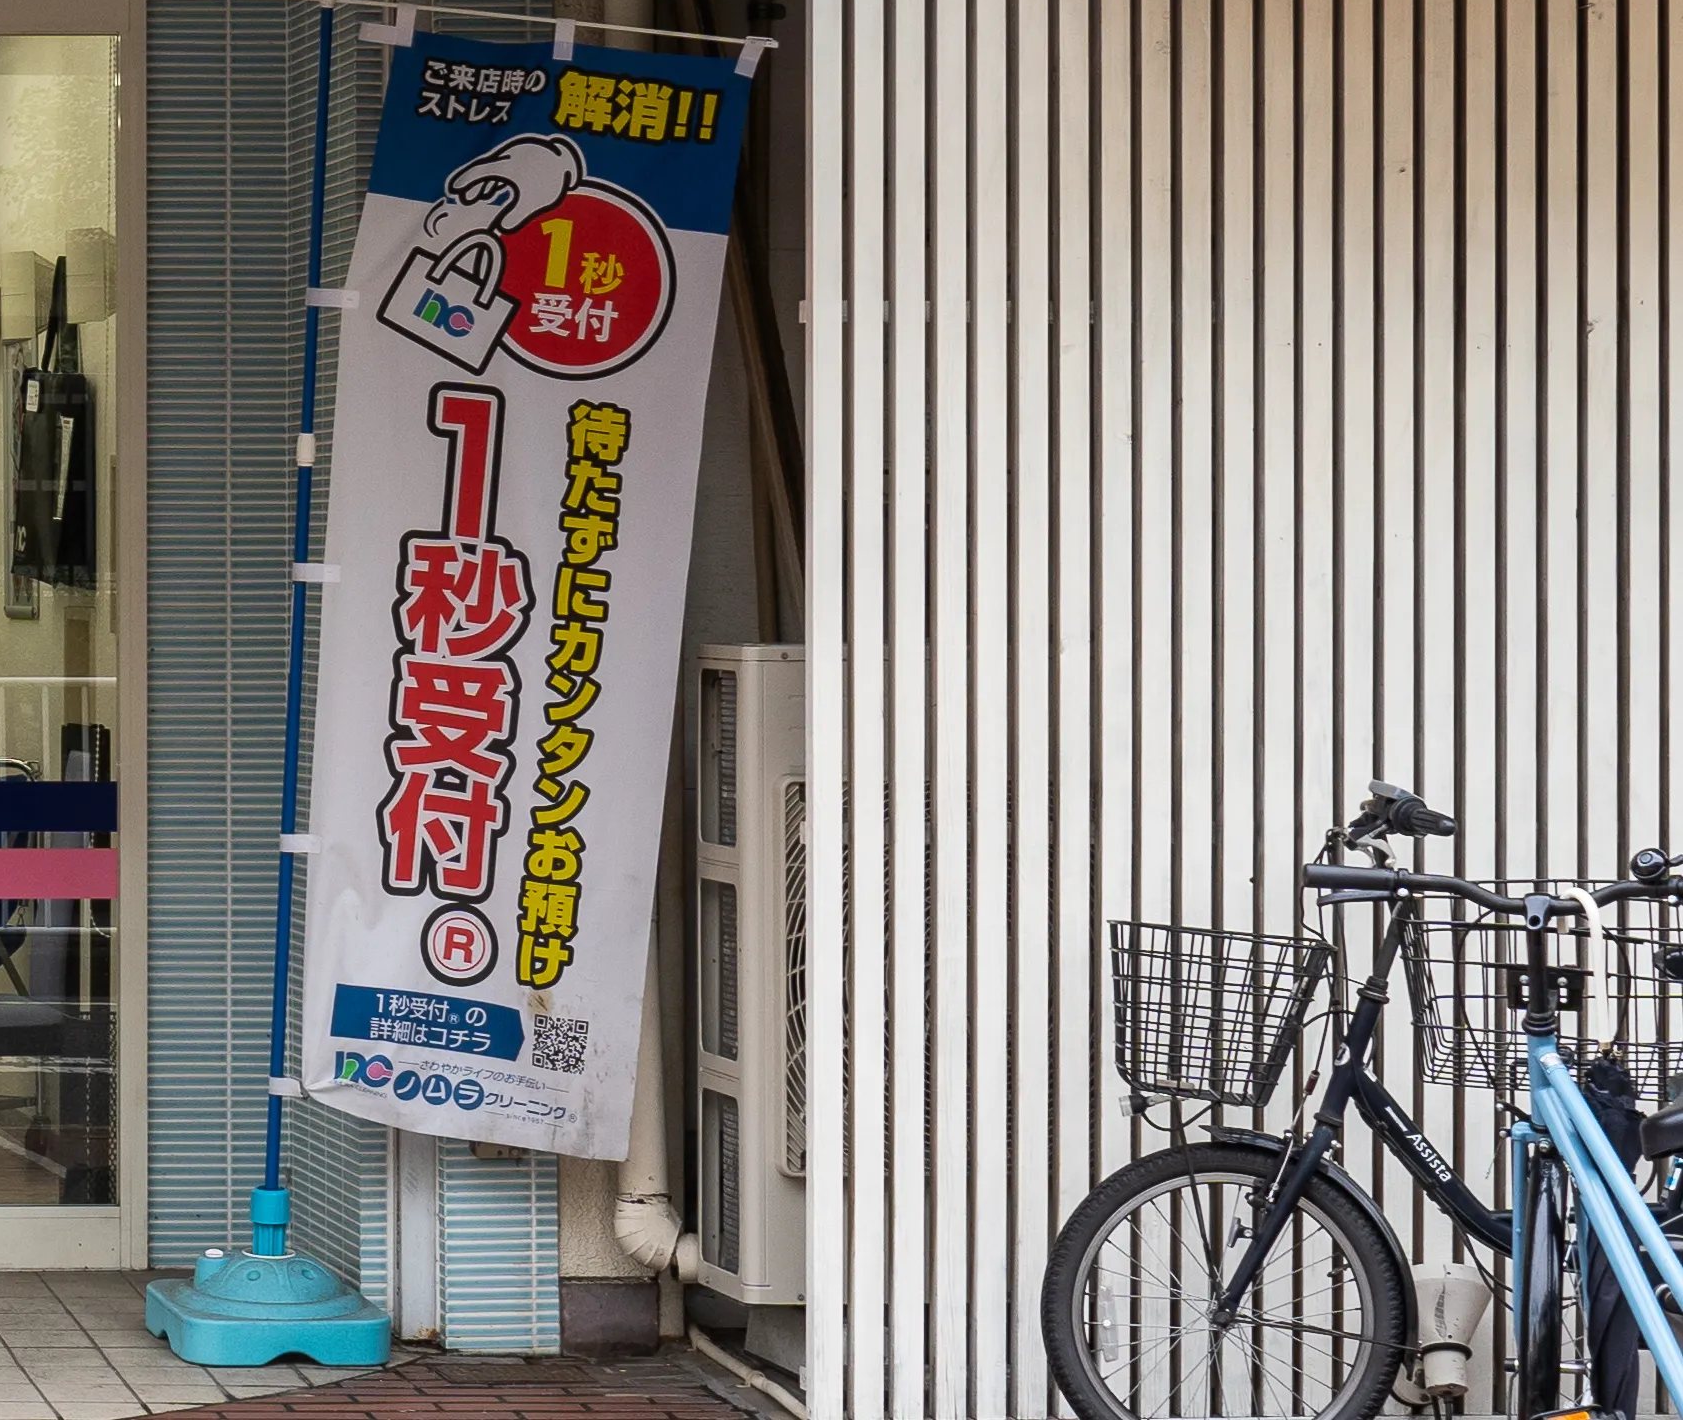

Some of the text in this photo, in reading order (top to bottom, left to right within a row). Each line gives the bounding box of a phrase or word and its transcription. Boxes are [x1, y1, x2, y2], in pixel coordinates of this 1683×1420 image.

[423, 61, 546, 95] ご来店時の
[417, 91, 511, 125] ストレス
[553, 70, 720, 141] 解消!!
[539, 216, 625, 296] 1秒
[529, 291, 619, 343] 受付
[519, 401, 630, 988] 待たずにカンタンお預け
[370, 1017, 491, 1052] 詳細はコチラ
[418, 1060, 546, 1091] さわやかライフのお手伝い
[1406, 1133, 1453, 1183] Assista
